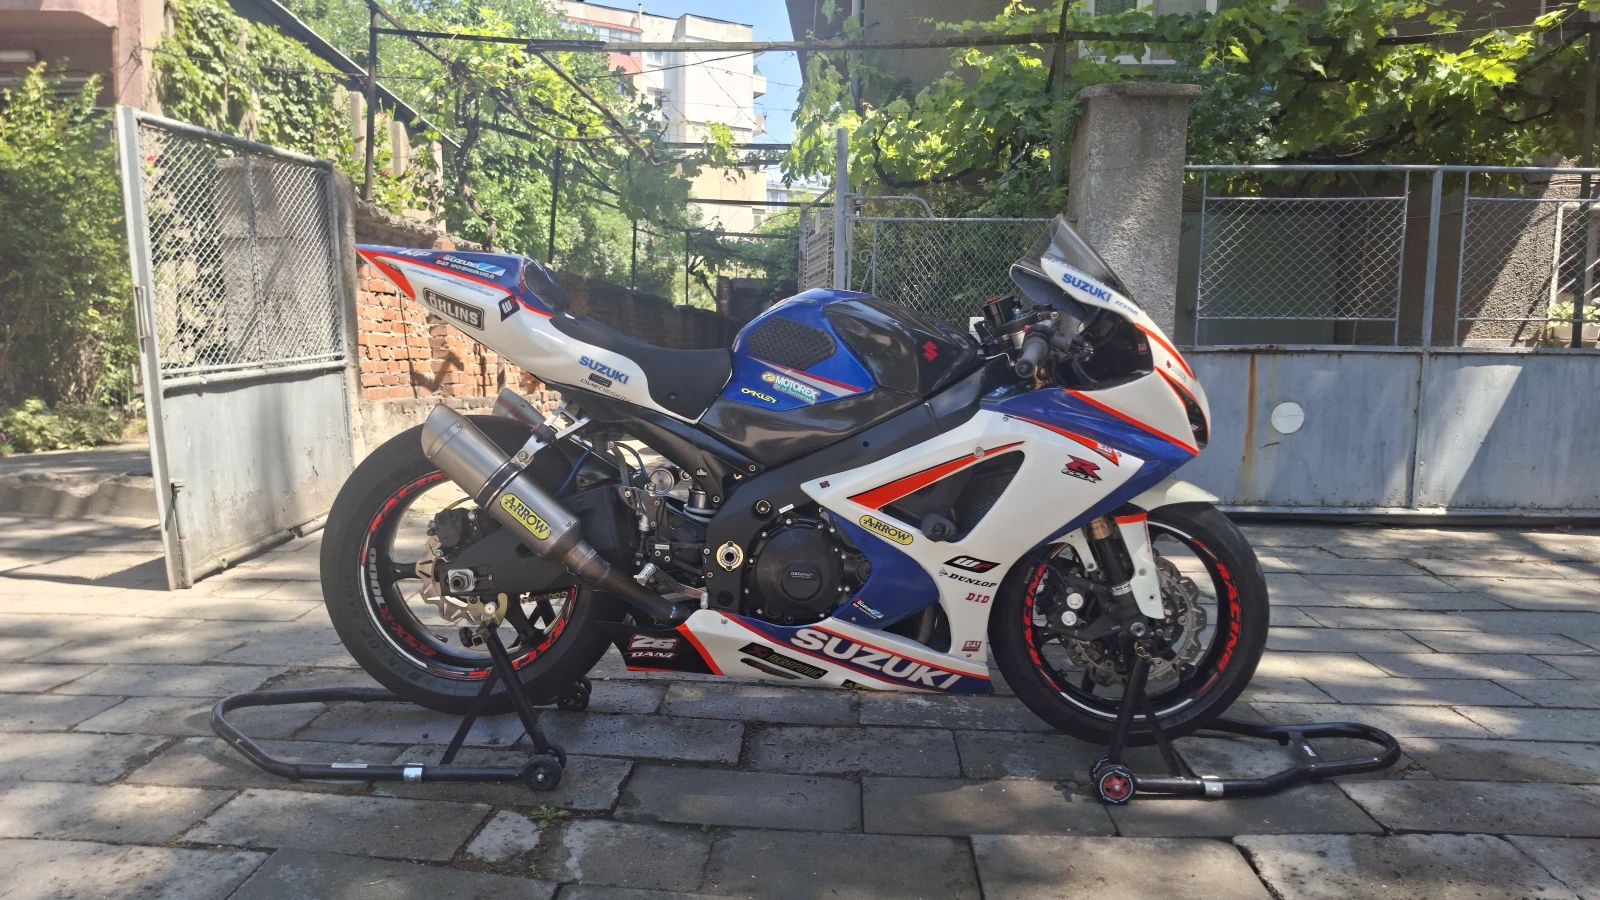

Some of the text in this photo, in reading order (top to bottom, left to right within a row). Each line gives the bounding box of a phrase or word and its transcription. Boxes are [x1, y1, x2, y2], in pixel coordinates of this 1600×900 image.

[1061, 273, 1112, 303] SUZUKI
[428, 292, 479, 326] ÖHLINS
[578, 355, 630, 385] SUZUKI
[774, 375, 819, 400] MOTOREX
[504, 496, 549, 534] ARROW
[863, 517, 911, 541] ARROW
[948, 573, 998, 588] DUNLOP
[630, 634, 678, 650] 26
[789, 627, 963, 690] SUZUKI
